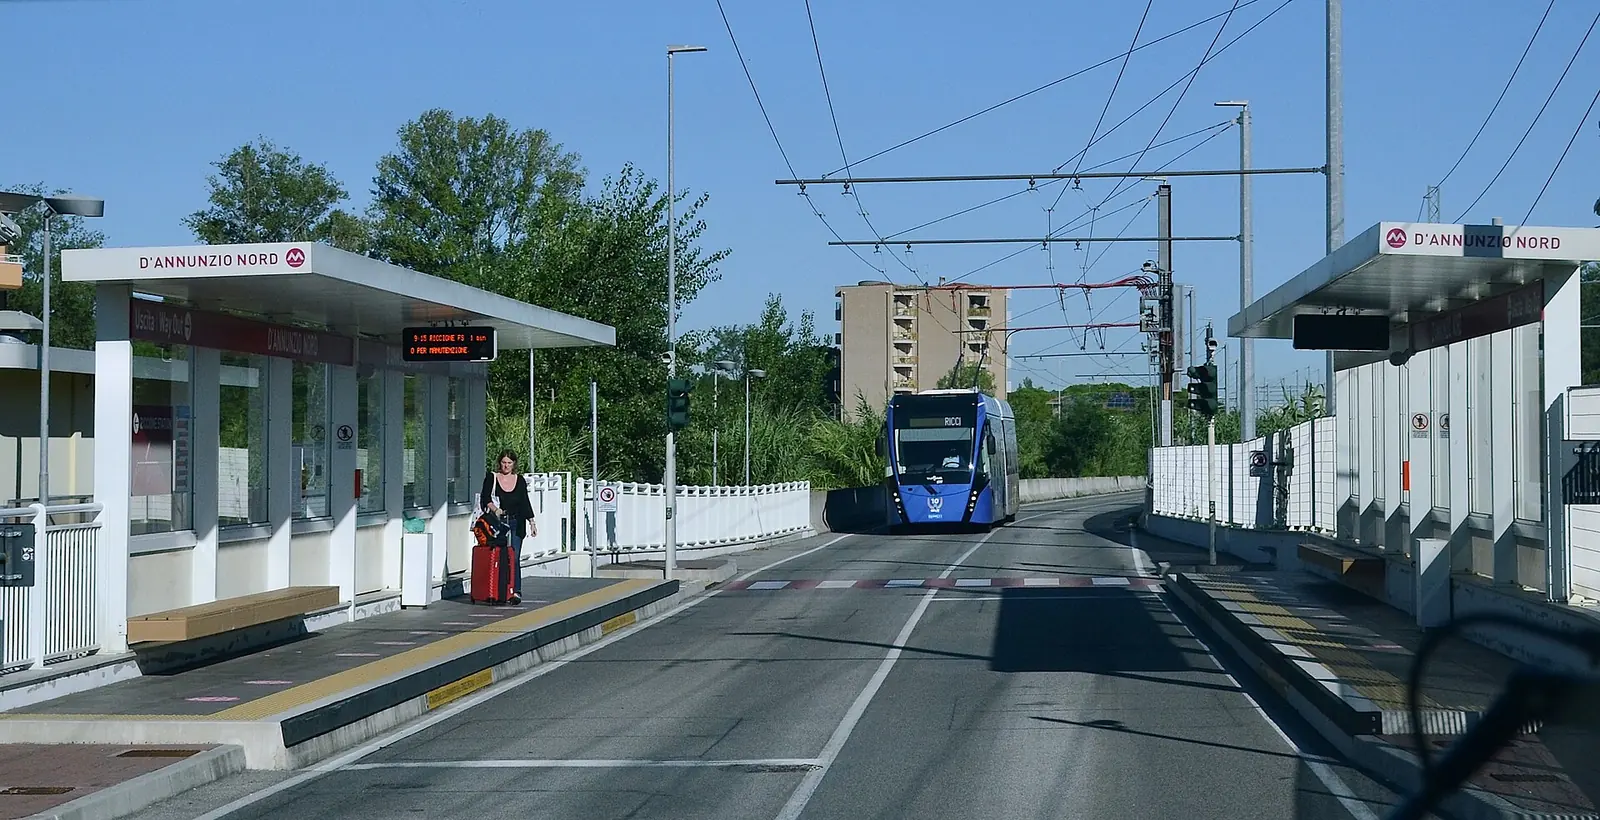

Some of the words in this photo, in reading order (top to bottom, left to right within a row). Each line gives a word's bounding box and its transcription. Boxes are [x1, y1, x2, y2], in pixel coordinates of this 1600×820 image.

[1414, 232, 1511, 248] D'ANNUNZIO
[1517, 236, 1560, 250] NORD
[139, 254, 232, 269] D'ANNUNZIO
[237, 253, 278, 266] NORD
[135, 308, 154, 331] Uscita
[160, 311, 172, 340] Way
[173, 313, 183, 335] Out
[267, 328, 301, 354] D'ANNUNZIO
[429, 334, 455, 342] RICCIONE
[457, 334, 465, 342] FS
[944, 416, 961, 426] RICCI
